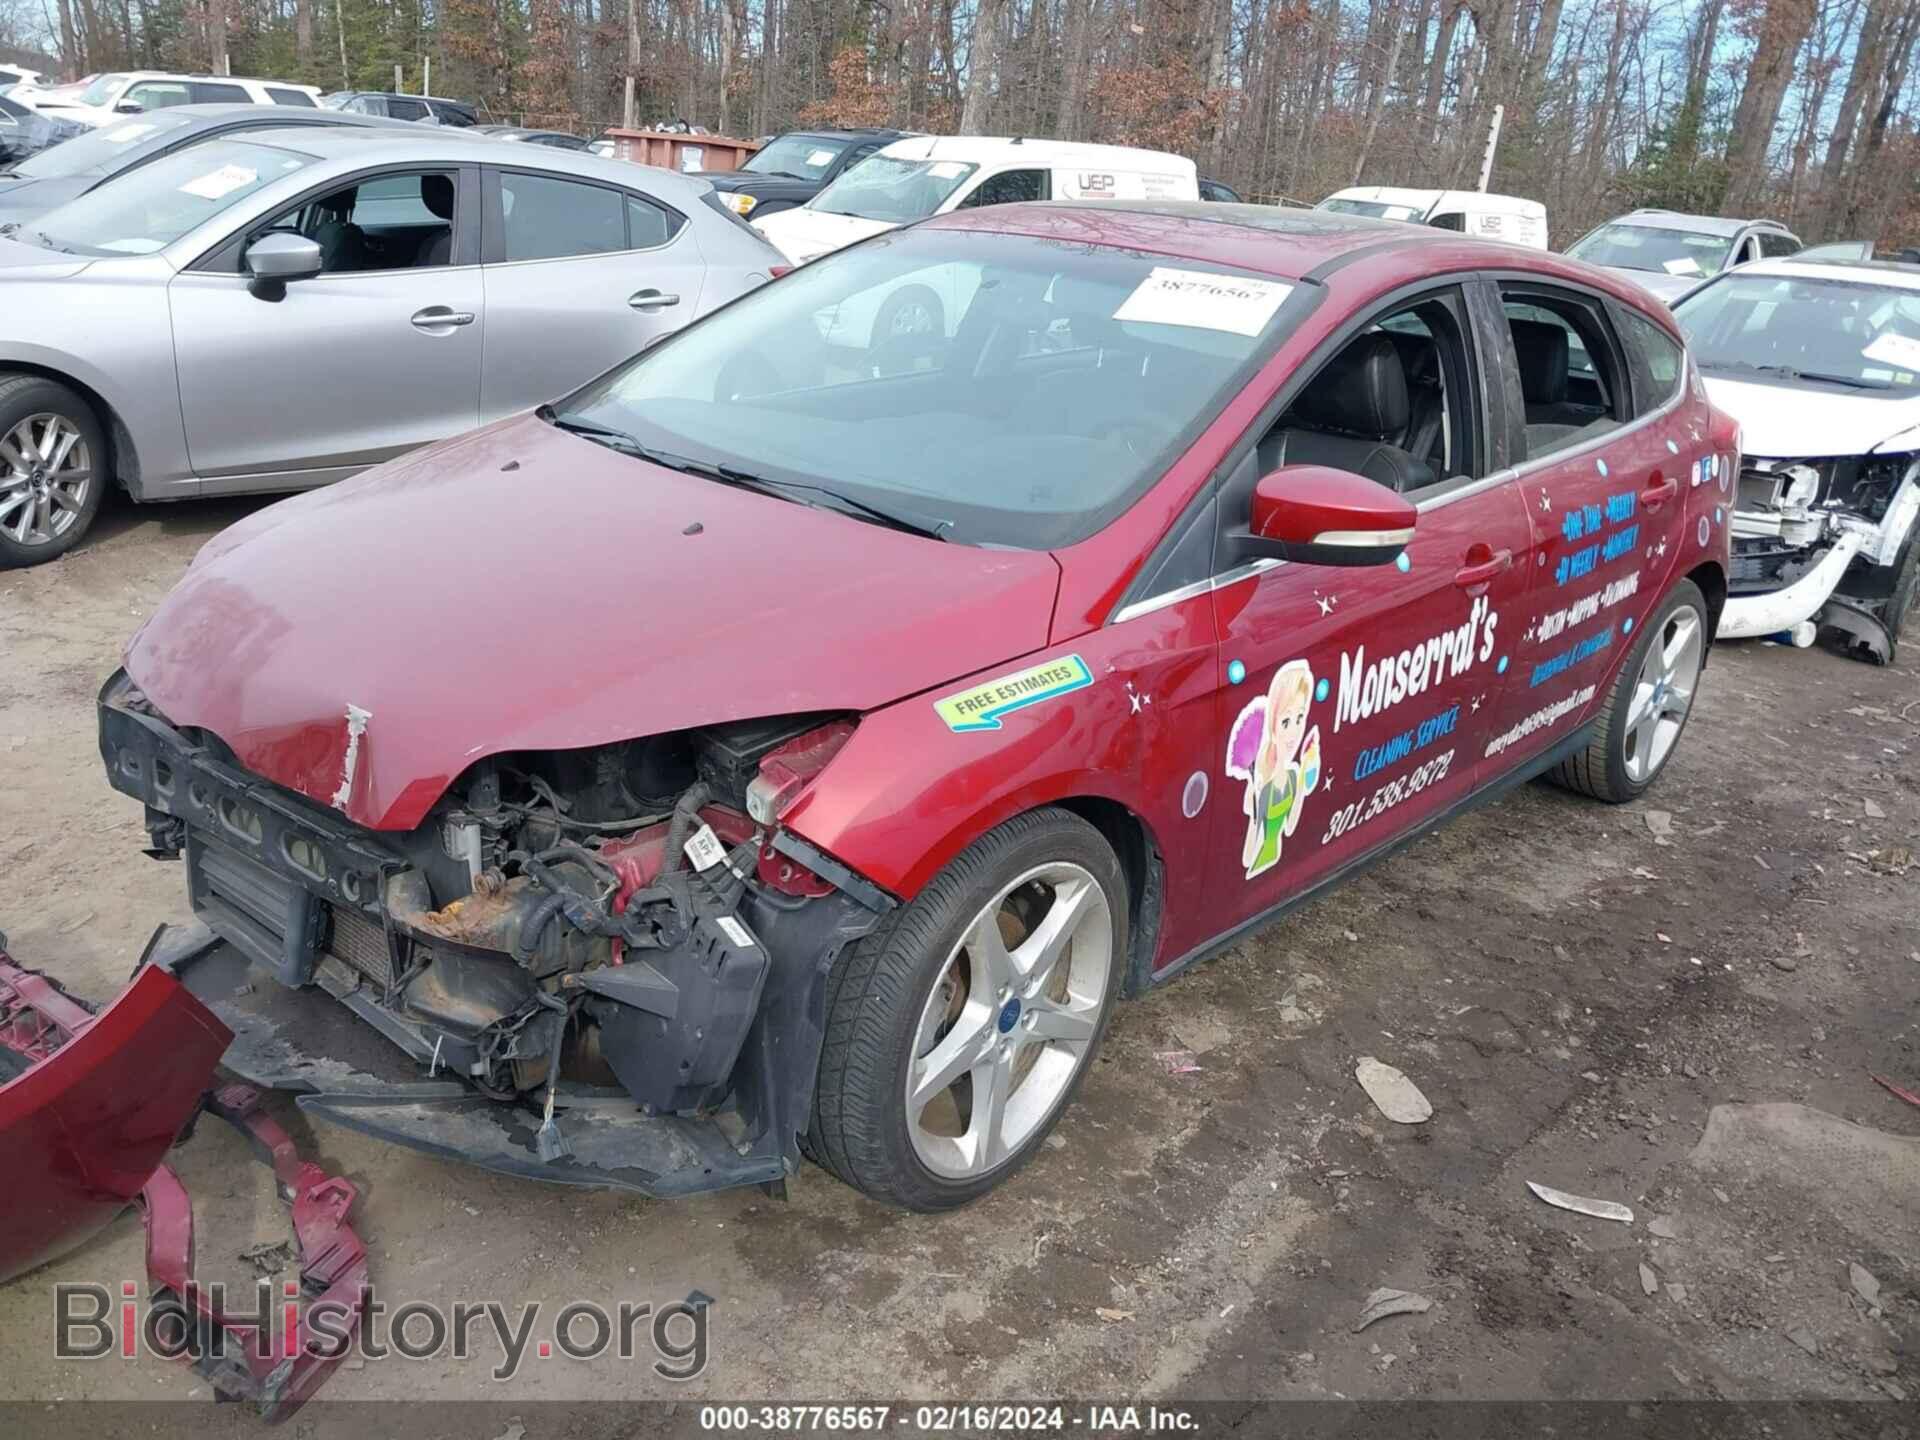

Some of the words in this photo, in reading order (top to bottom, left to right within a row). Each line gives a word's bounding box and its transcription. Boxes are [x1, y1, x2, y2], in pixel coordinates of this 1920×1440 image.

[1079, 172, 1115, 191] UEP
[955, 691, 997, 715] FREE
[995, 666, 1073, 701] ESTIMATES
[1333, 595, 1499, 734] Monserrat's
[1354, 729, 1414, 781] CLEANING
[1413, 704, 1461, 750] SERVICE
